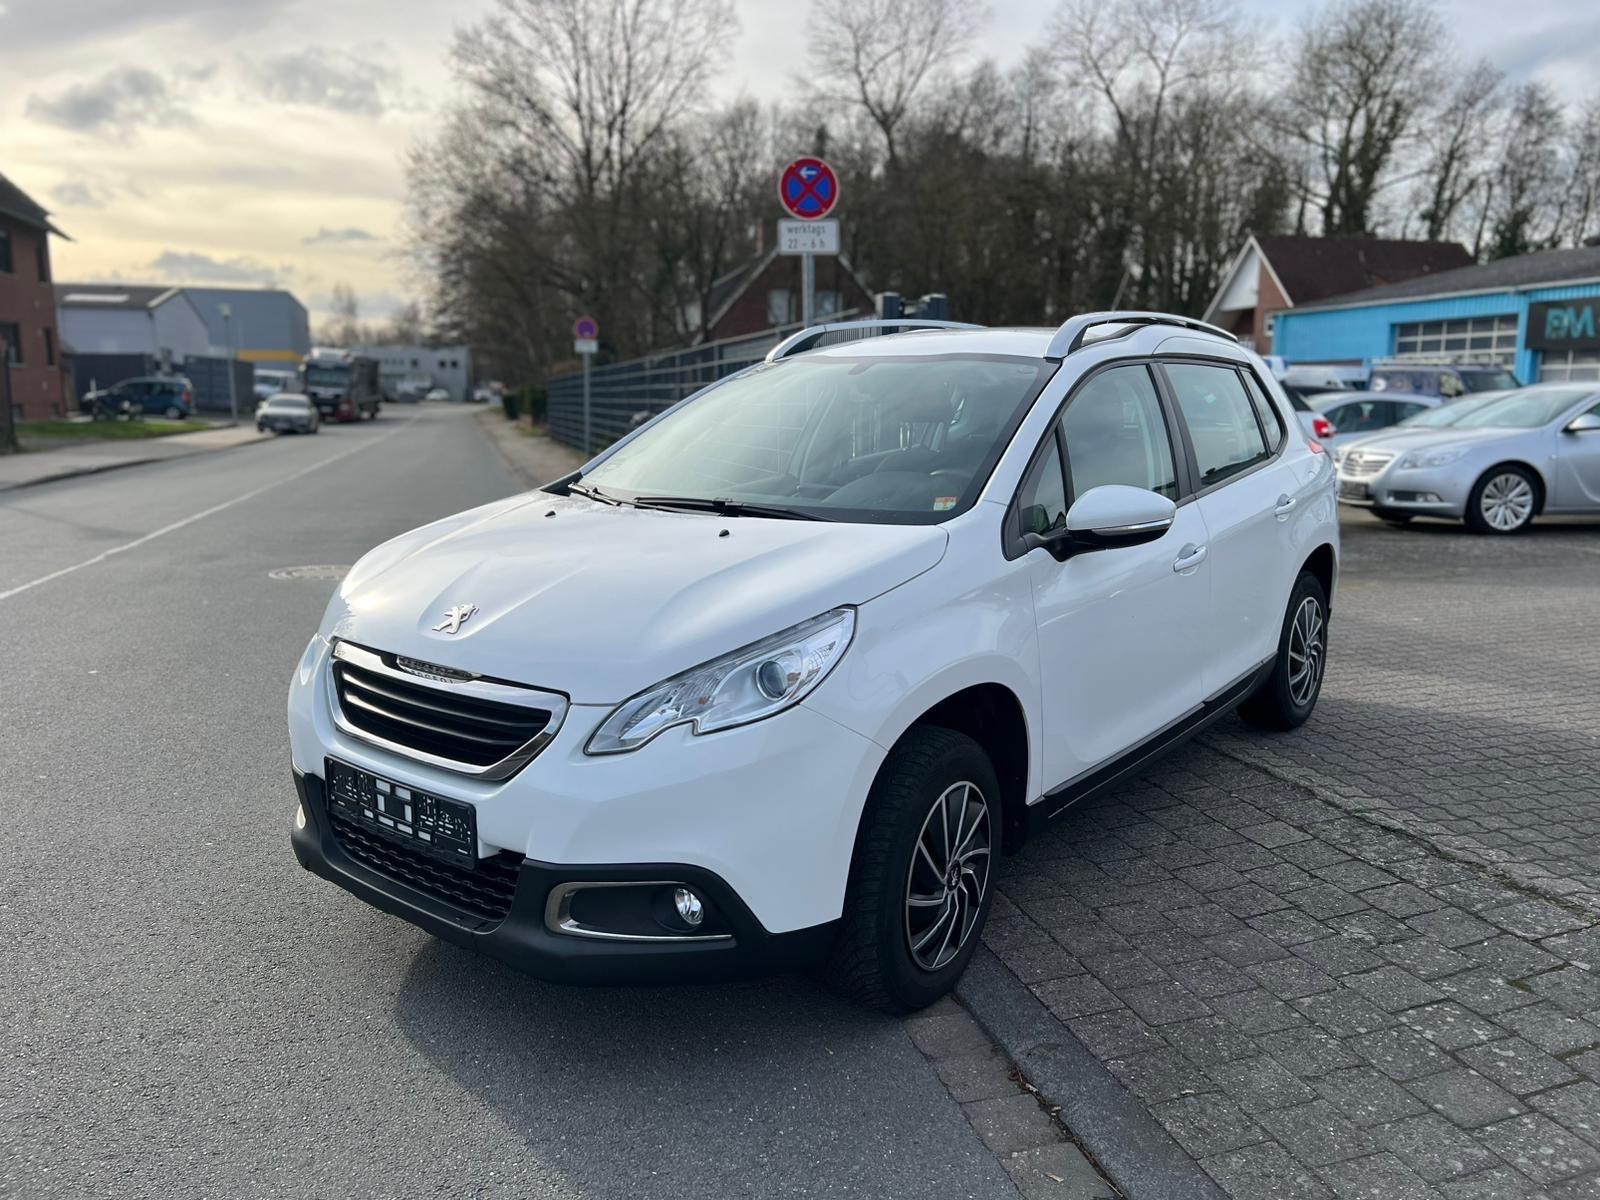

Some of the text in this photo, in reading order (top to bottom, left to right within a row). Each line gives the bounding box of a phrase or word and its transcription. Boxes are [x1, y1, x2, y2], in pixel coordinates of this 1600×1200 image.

[787, 224, 826, 237] werktags
[788, 238, 798, 249] 22
[819, 238, 826, 249] h
